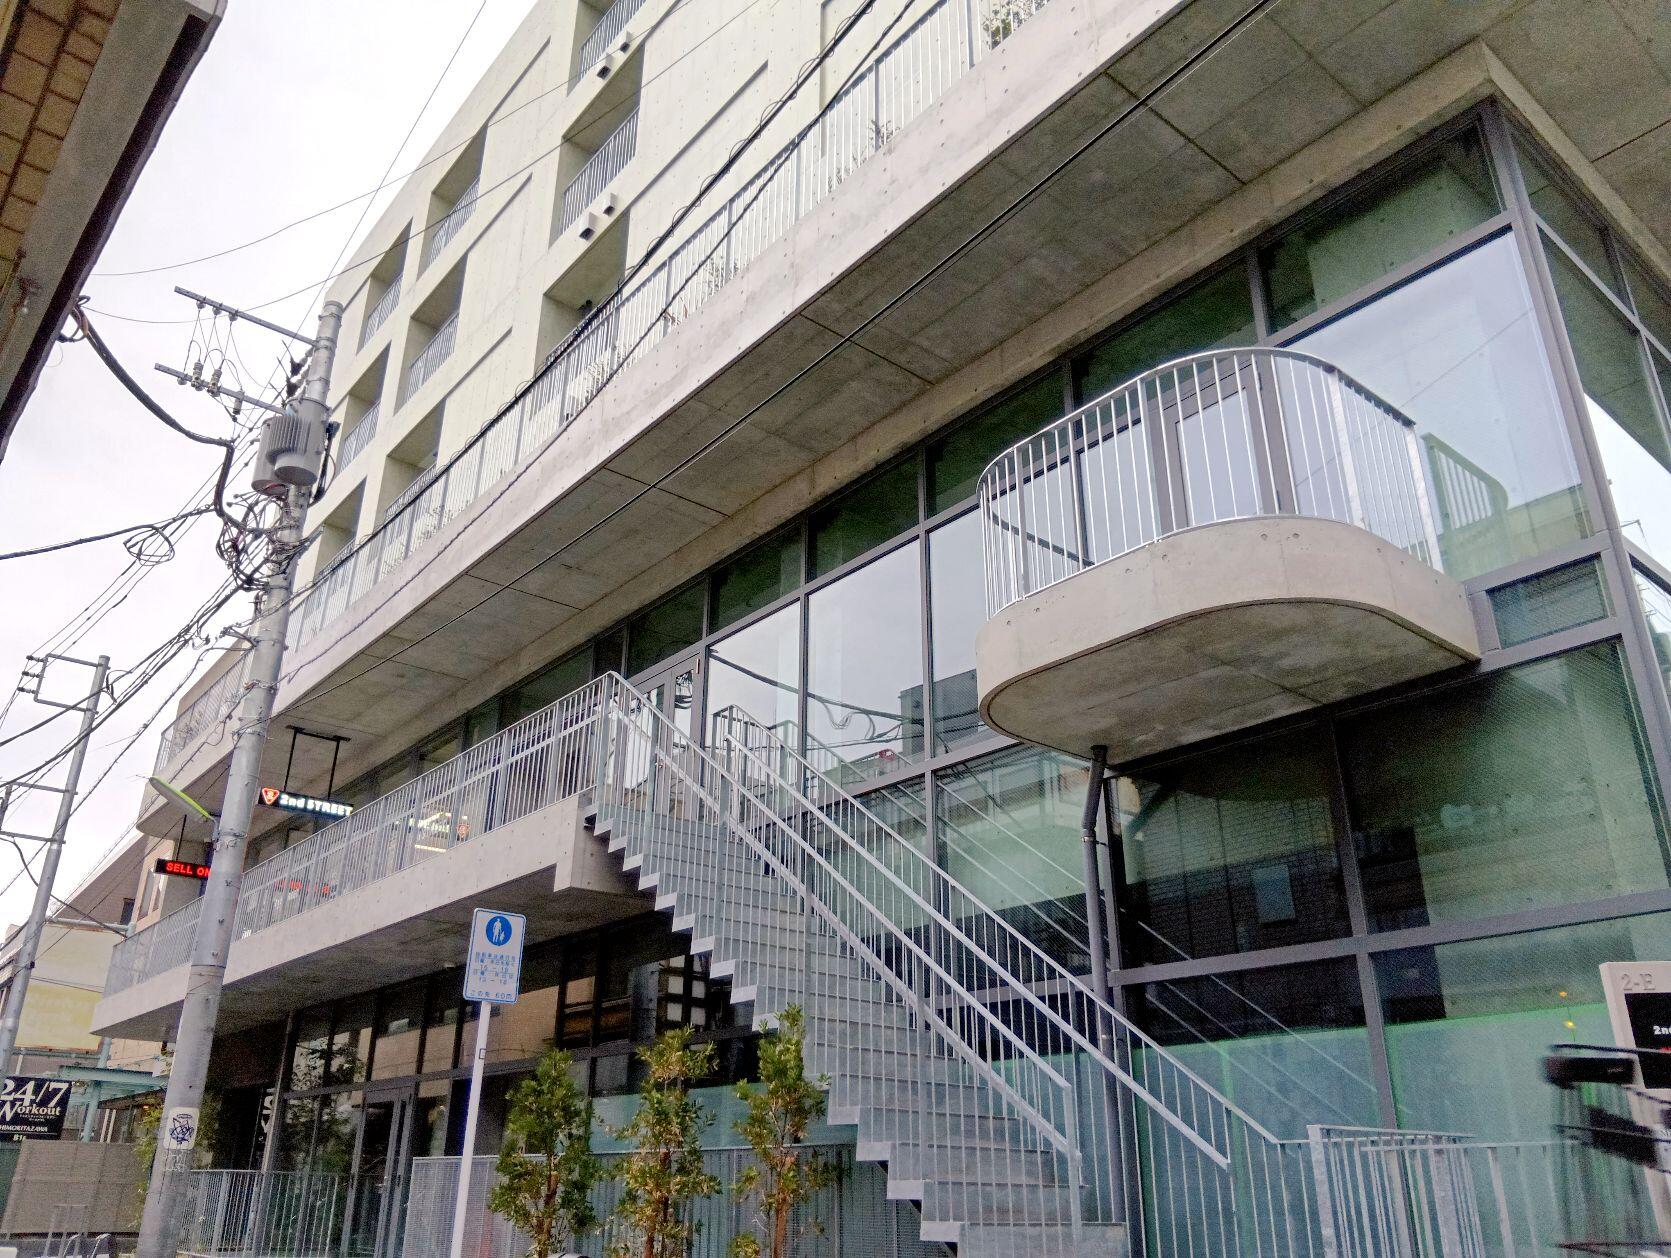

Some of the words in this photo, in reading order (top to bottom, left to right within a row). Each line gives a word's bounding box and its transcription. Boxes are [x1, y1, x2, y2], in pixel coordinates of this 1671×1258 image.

[280, 793, 306, 809] 2nd
[306, 799, 354, 817] STREET
[166, 862, 193, 875] SELL
[0, 1079, 70, 1107] 24/7
[0, 1124, 48, 1132] HIMOKITAZAWA
